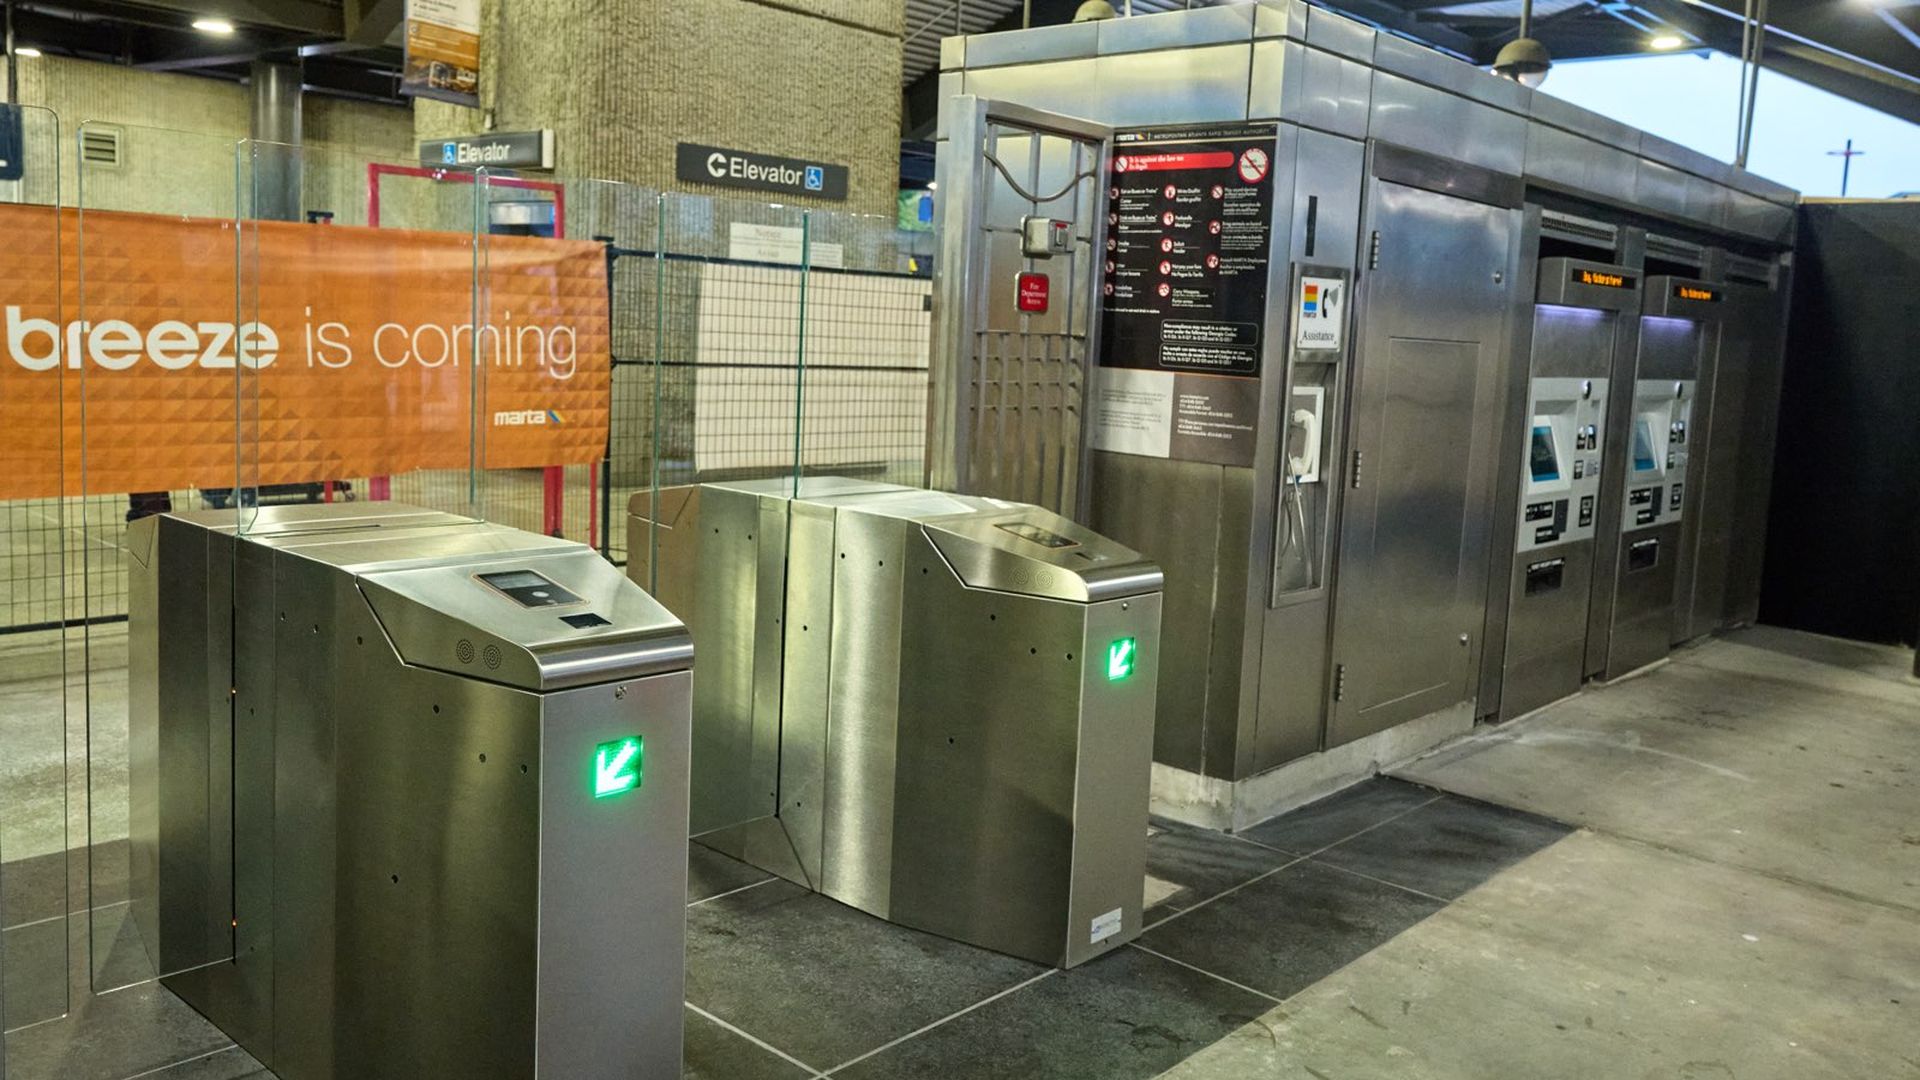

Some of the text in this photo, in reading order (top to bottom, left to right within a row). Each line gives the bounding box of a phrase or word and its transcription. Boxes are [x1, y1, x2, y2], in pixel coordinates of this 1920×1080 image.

[457, 142, 511, 163] Elevator
[729, 157, 803, 185] Elevator
[1021, 290, 1047, 298] Department
[5, 306, 578, 379] breeze is coming
[1302, 330, 1335, 341] Assistance
[493, 409, 546, 427] marta
